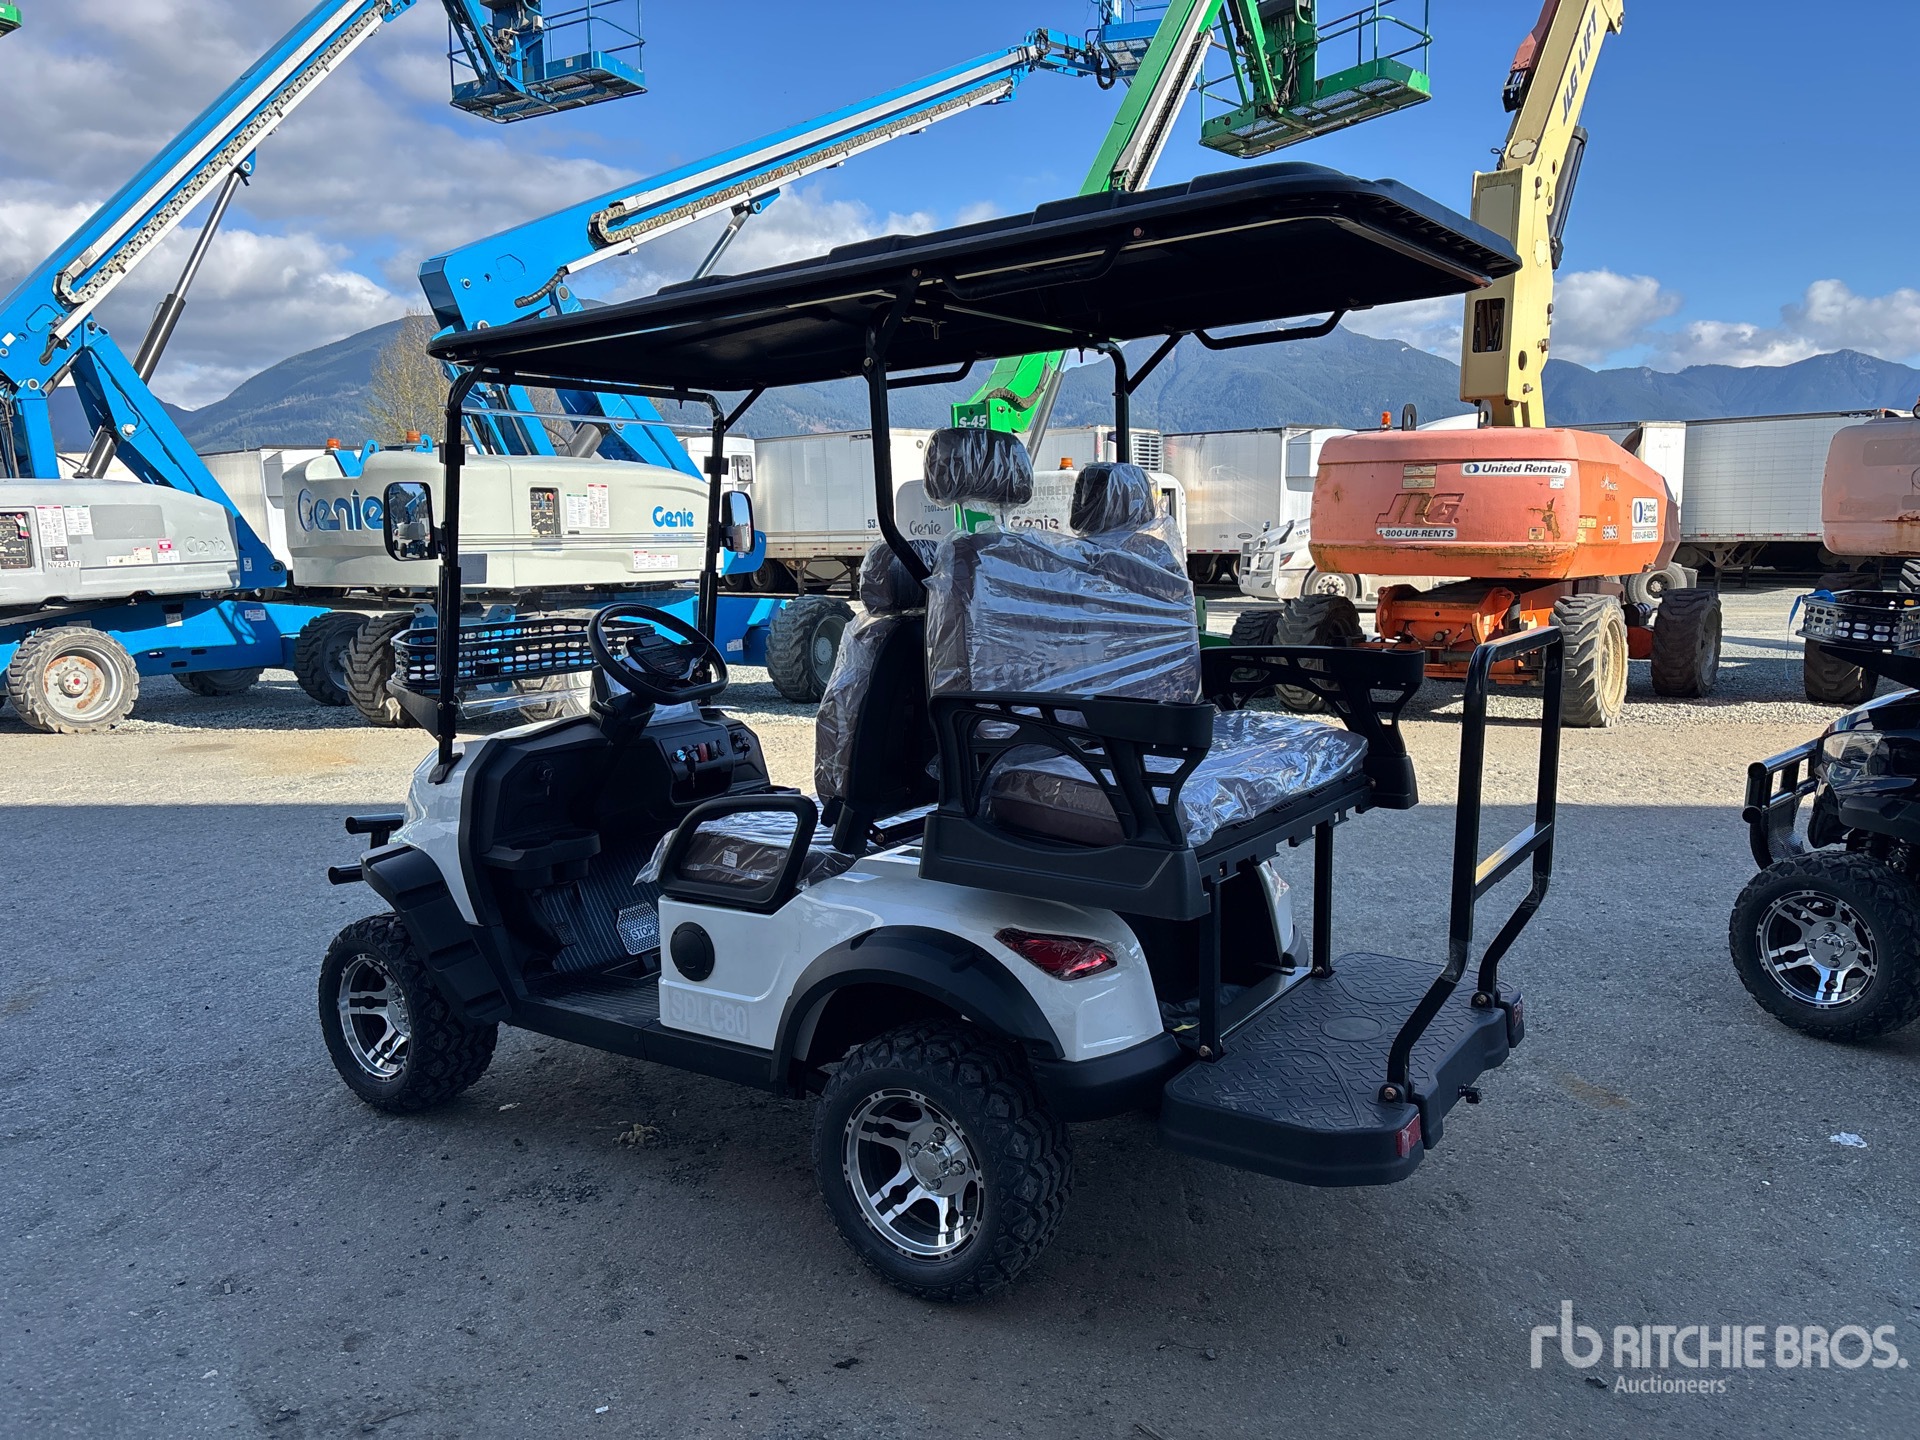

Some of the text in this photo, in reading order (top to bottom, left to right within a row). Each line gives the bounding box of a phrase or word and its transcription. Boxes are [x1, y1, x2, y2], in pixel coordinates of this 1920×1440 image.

[1562, 6, 1597, 126] JLG LIFT
[958, 414, 987, 427] S-45
[1482, 463, 1567, 475] United Rentals
[298, 488, 384, 533] Genie
[652, 505, 694, 528] Genie
[867, 519, 876, 529] 53
[909, 519, 942, 536] Genie
[631, 925, 653, 939] STOP
